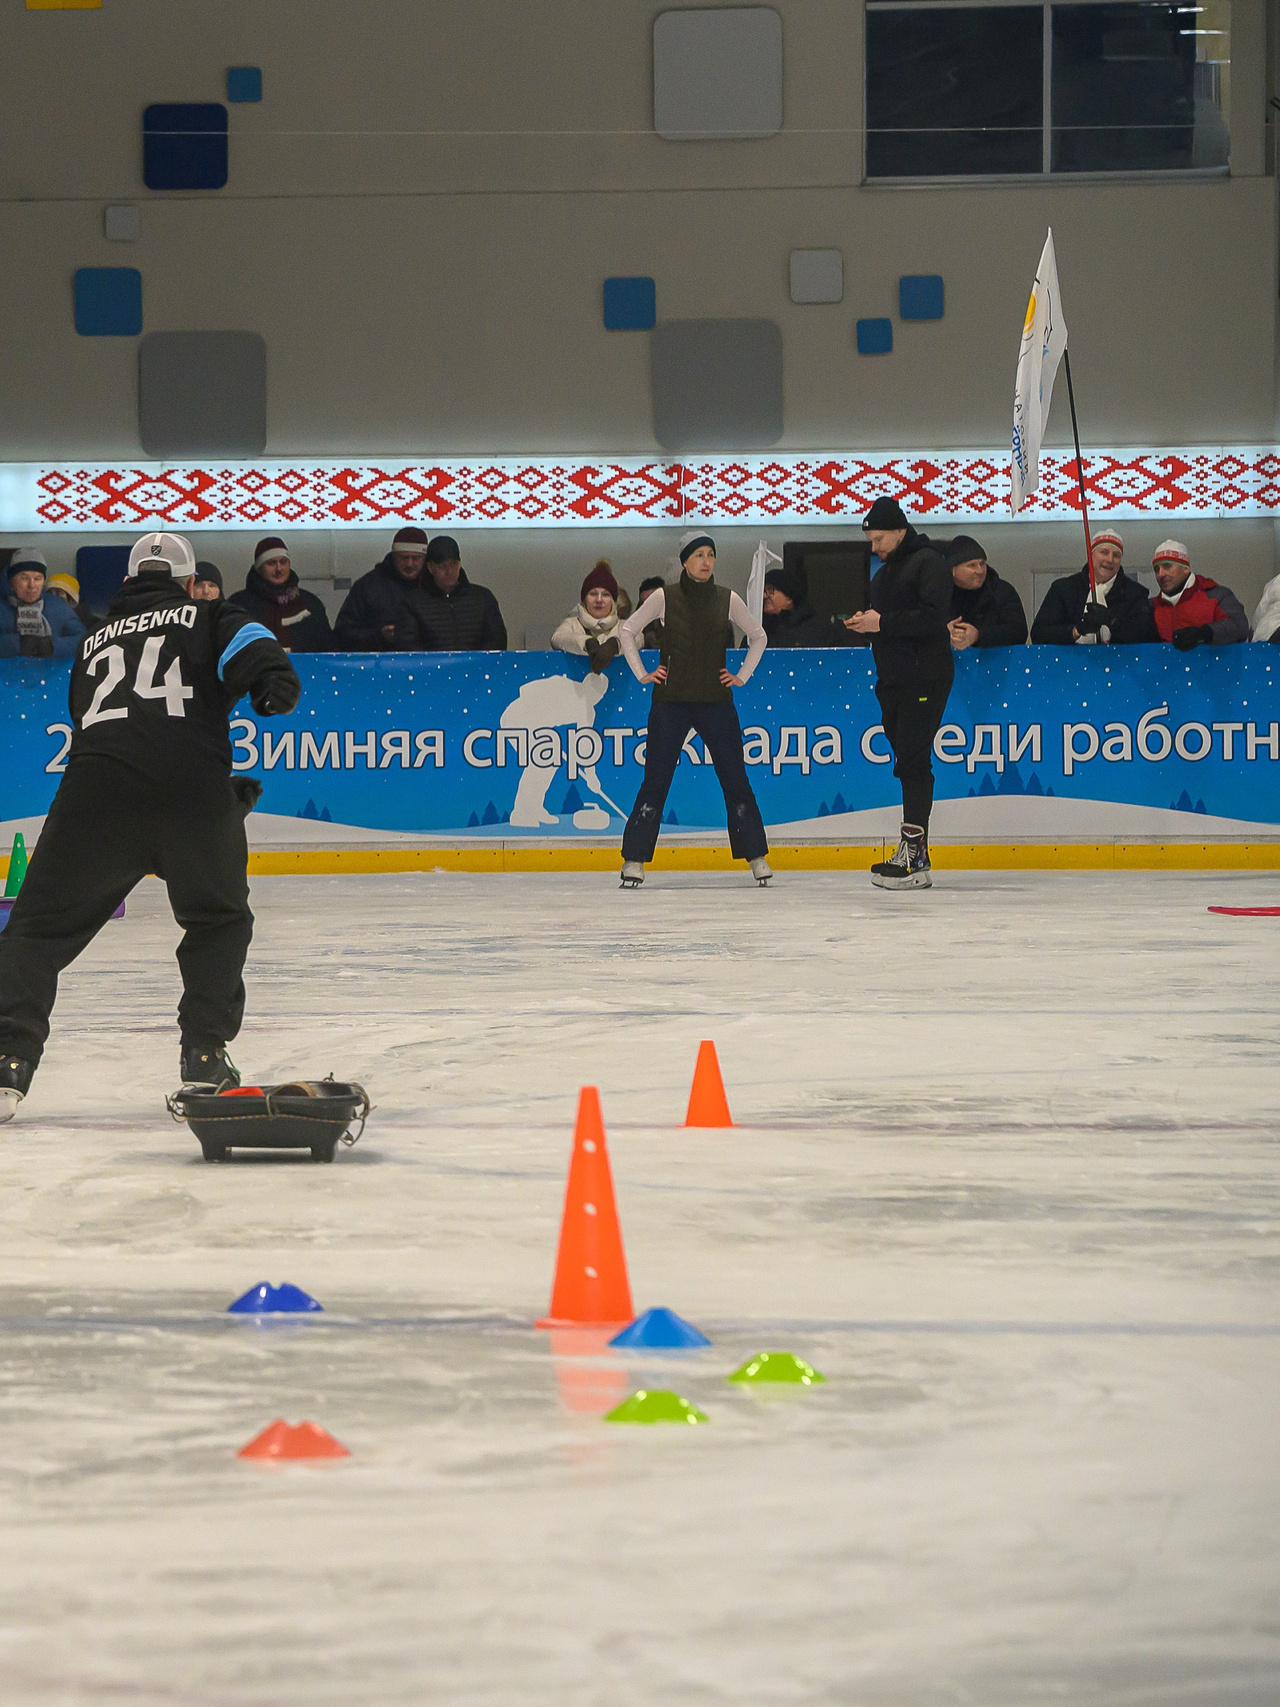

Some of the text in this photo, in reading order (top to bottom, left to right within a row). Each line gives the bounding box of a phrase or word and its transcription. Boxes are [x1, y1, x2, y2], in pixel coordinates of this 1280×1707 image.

[83, 604, 198, 660] DENISENKO
[81, 634, 194, 730] 24
[229, 718, 444, 770] Зимняя
[859, 722, 1042, 774] седи
